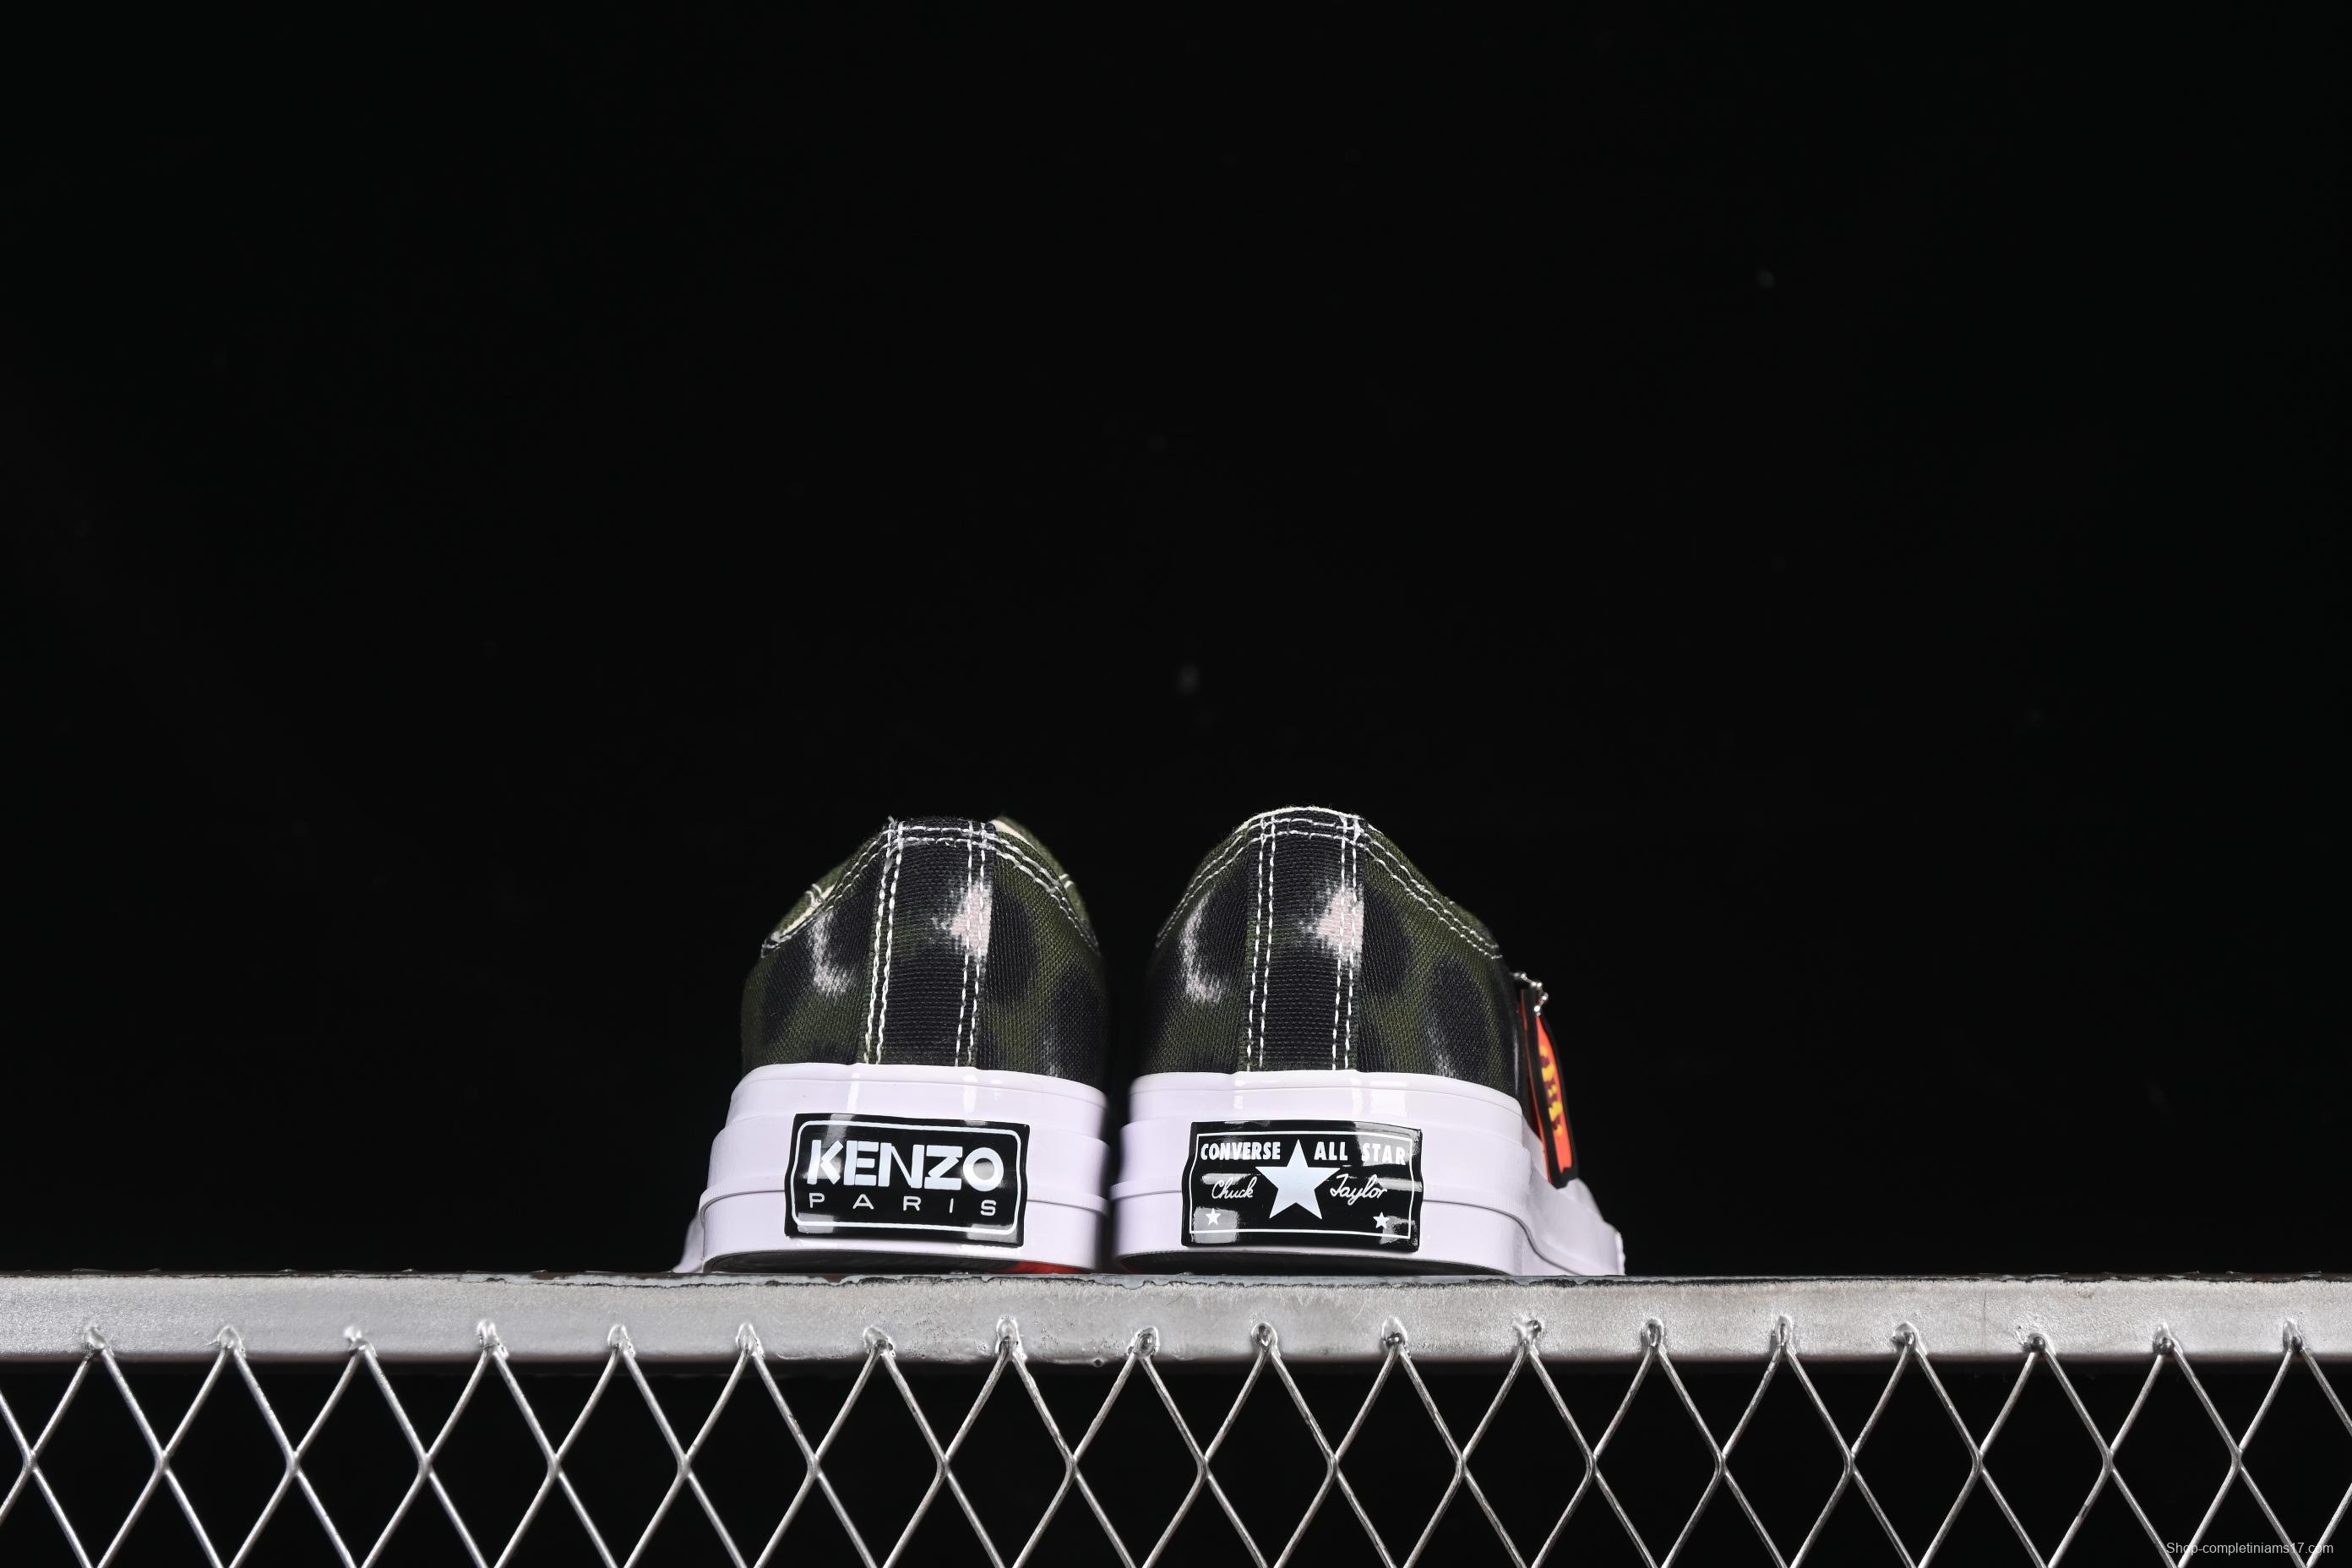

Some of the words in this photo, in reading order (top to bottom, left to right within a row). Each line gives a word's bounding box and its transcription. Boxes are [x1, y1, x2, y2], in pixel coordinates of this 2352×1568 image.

[807, 1140, 1004, 1191] KENZO
[1200, 1141, 1281, 1160] CONVERSE
[1314, 1141, 1348, 1161] ALL
[1361, 1143, 1407, 1165] STAR
[1211, 1176, 1257, 1199] Chuck
[1330, 1173, 1387, 1206] Taylor
[809, 1192, 997, 1216] PARIS
